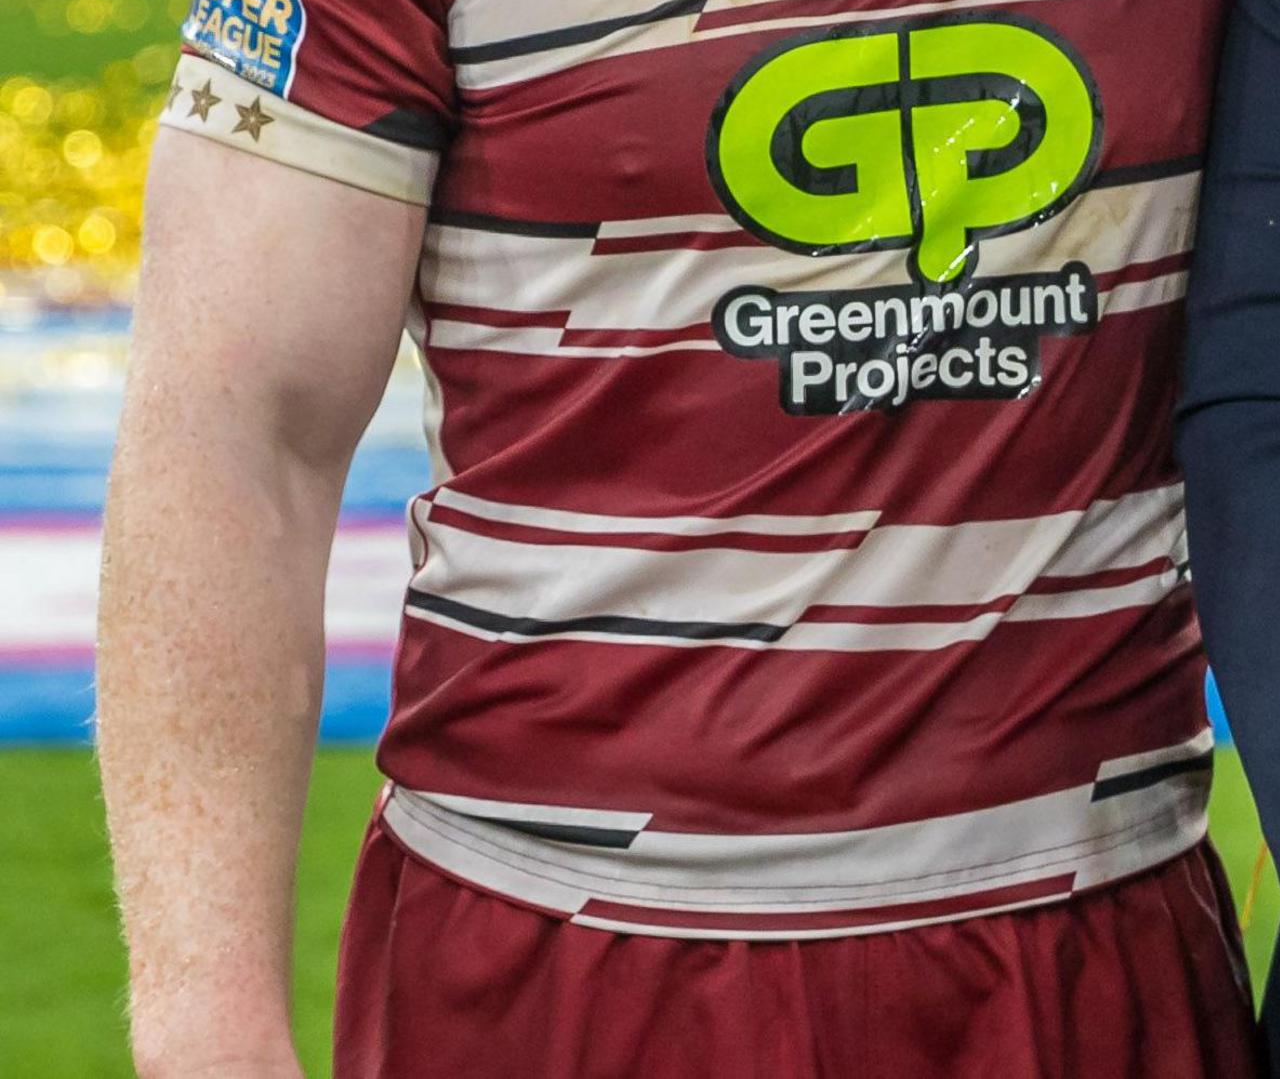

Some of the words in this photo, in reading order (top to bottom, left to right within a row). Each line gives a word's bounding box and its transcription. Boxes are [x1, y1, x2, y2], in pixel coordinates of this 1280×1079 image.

[719, 22, 1094, 282] GP
[724, 272, 1088, 348] Greenmount
[791, 337, 1028, 404] Projects
